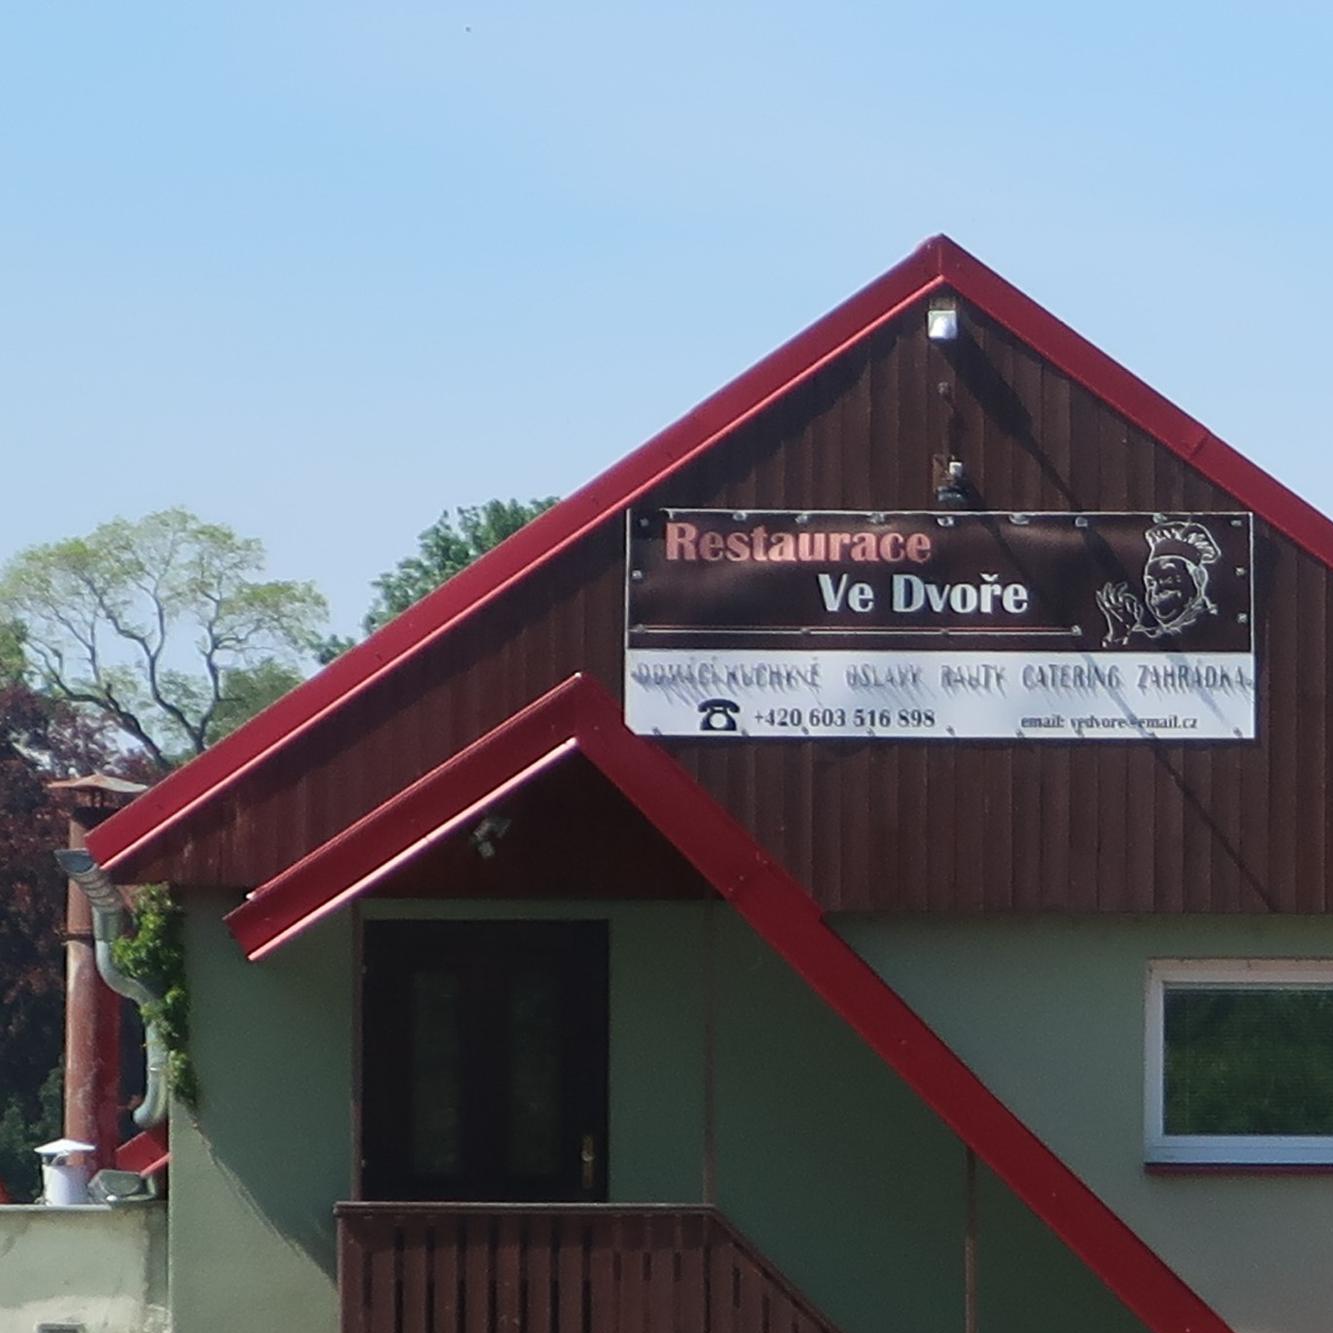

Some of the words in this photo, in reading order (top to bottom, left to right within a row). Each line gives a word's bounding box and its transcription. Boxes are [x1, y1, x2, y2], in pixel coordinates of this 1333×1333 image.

[666, 522, 931, 562] Restaurace
[818, 573, 874, 612] Ve
[892, 573, 1028, 613] Dvoře
[1022, 664, 1120, 688] CATERING
[755, 709, 801, 727] +420
[808, 709, 846, 727] 603
[853, 709, 891, 727] 516
[898, 709, 935, 727] 898
